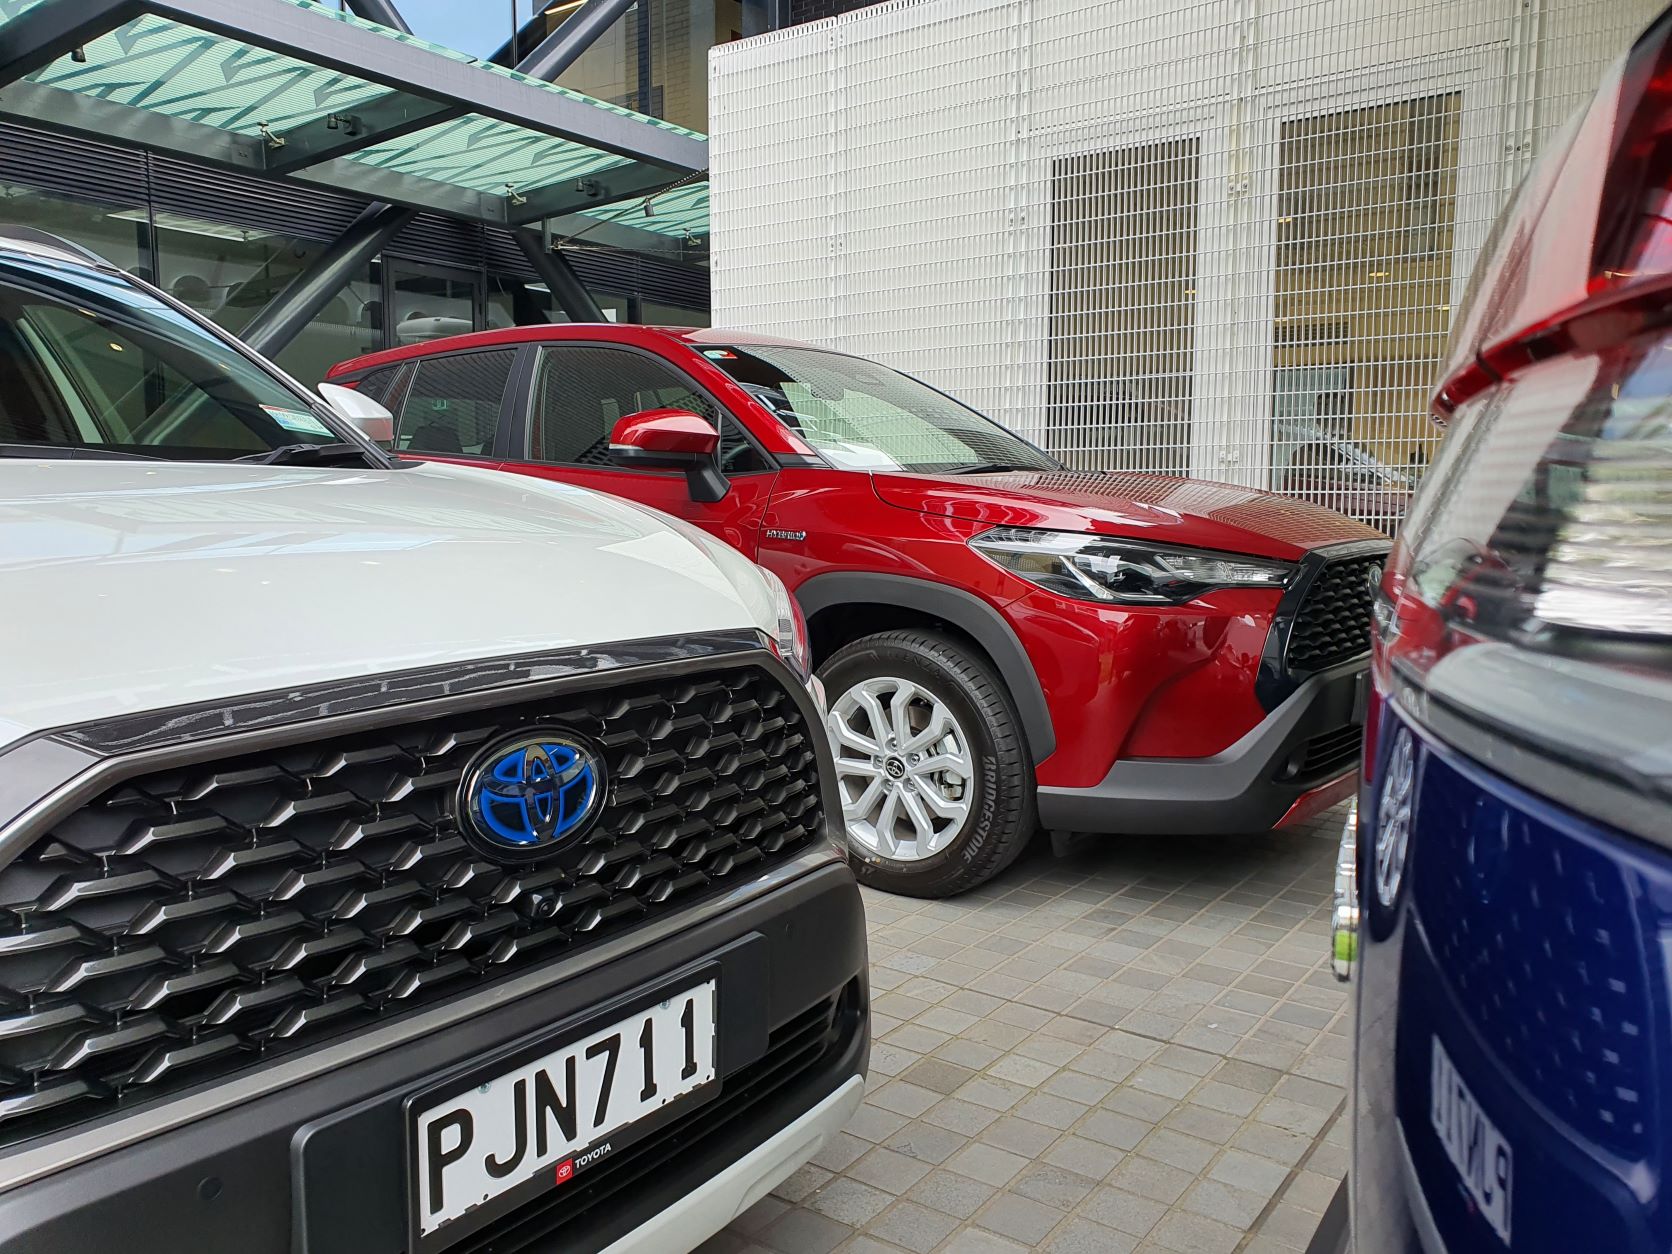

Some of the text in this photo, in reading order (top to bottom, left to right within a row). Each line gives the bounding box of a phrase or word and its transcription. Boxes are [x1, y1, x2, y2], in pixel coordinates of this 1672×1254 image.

[963, 755, 997, 864] BRIDGESTONE
[428, 998, 697, 1215] PJN711
[575, 1143, 612, 1168] TOYOTA
